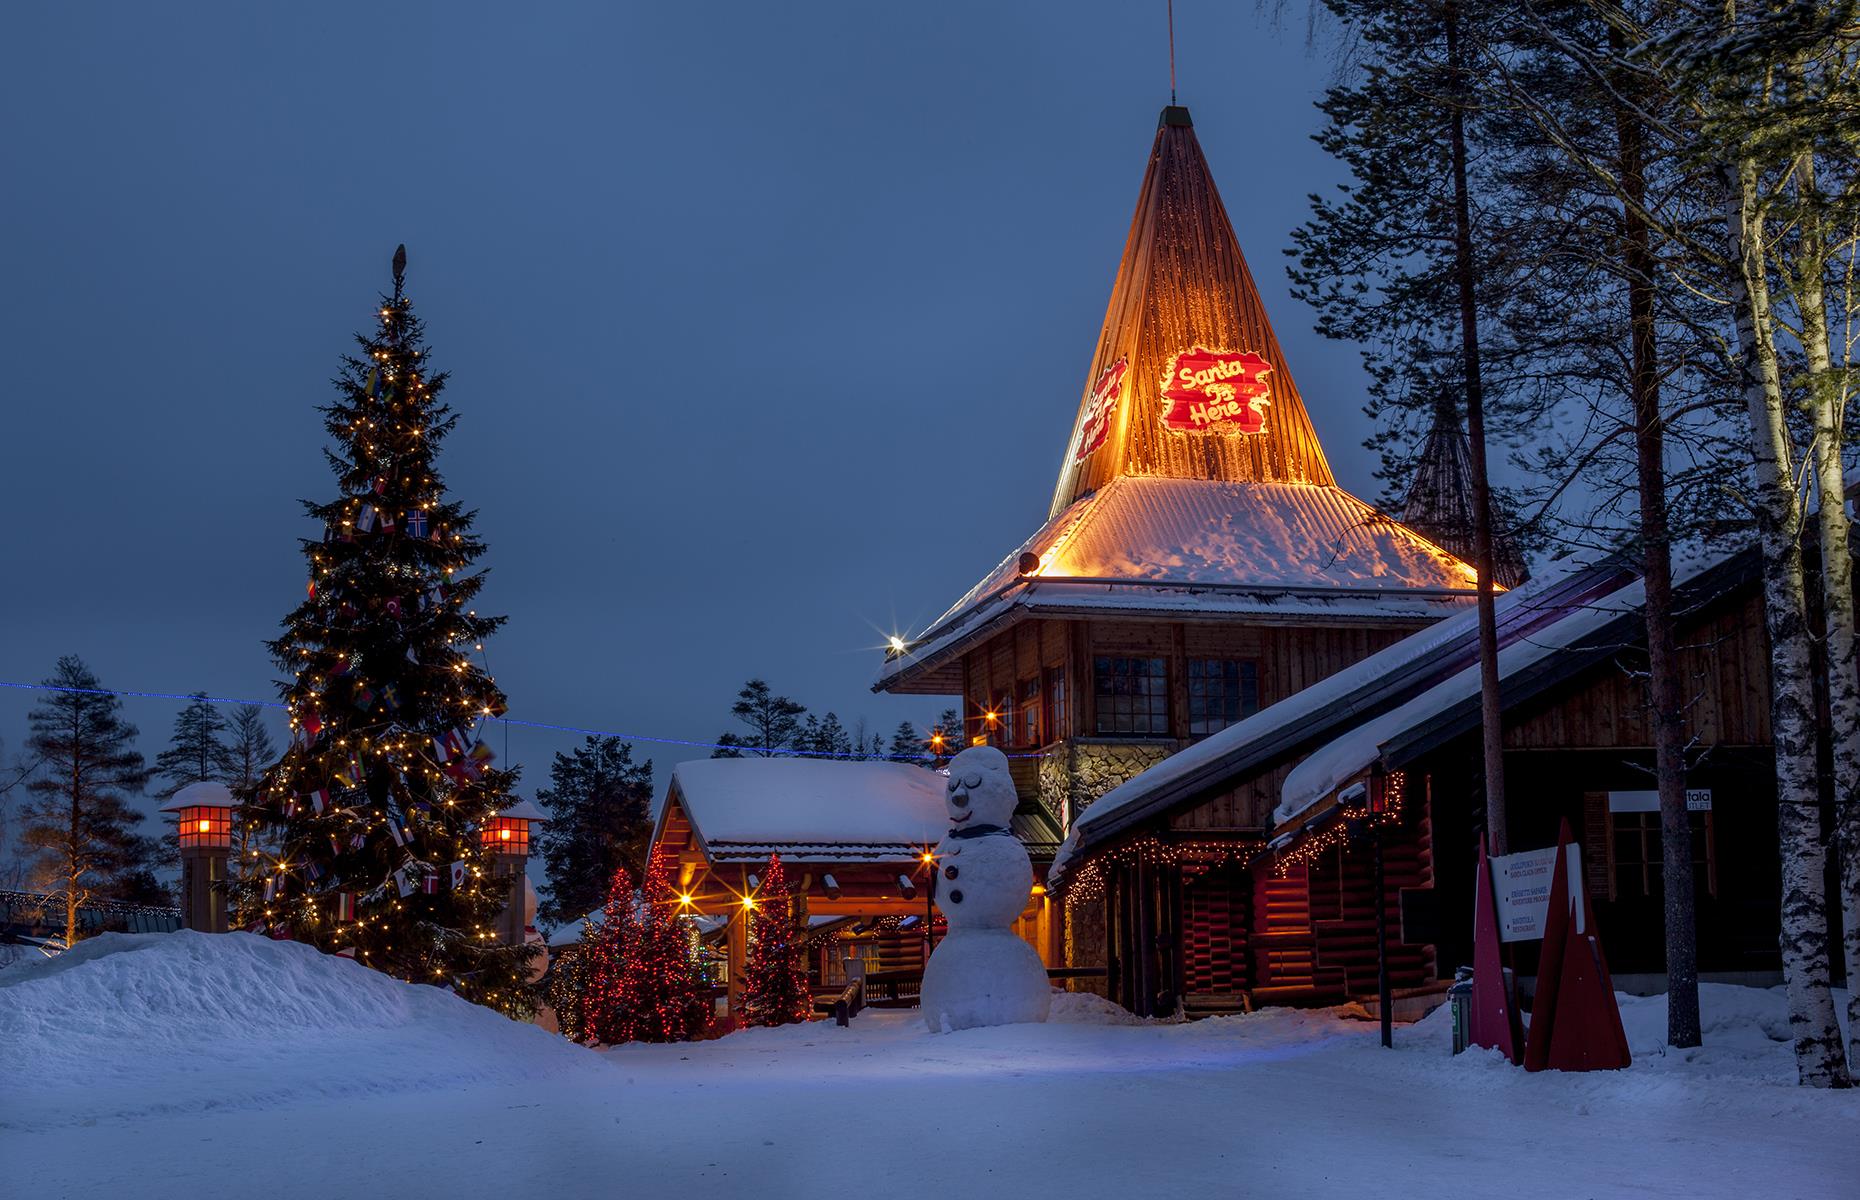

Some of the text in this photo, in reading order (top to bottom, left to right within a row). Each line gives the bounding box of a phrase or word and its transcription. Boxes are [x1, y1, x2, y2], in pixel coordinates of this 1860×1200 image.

[1179, 359, 1245, 389] Santa
[1190, 401, 1242, 426] Here
[1688, 791, 1710, 802] tala
